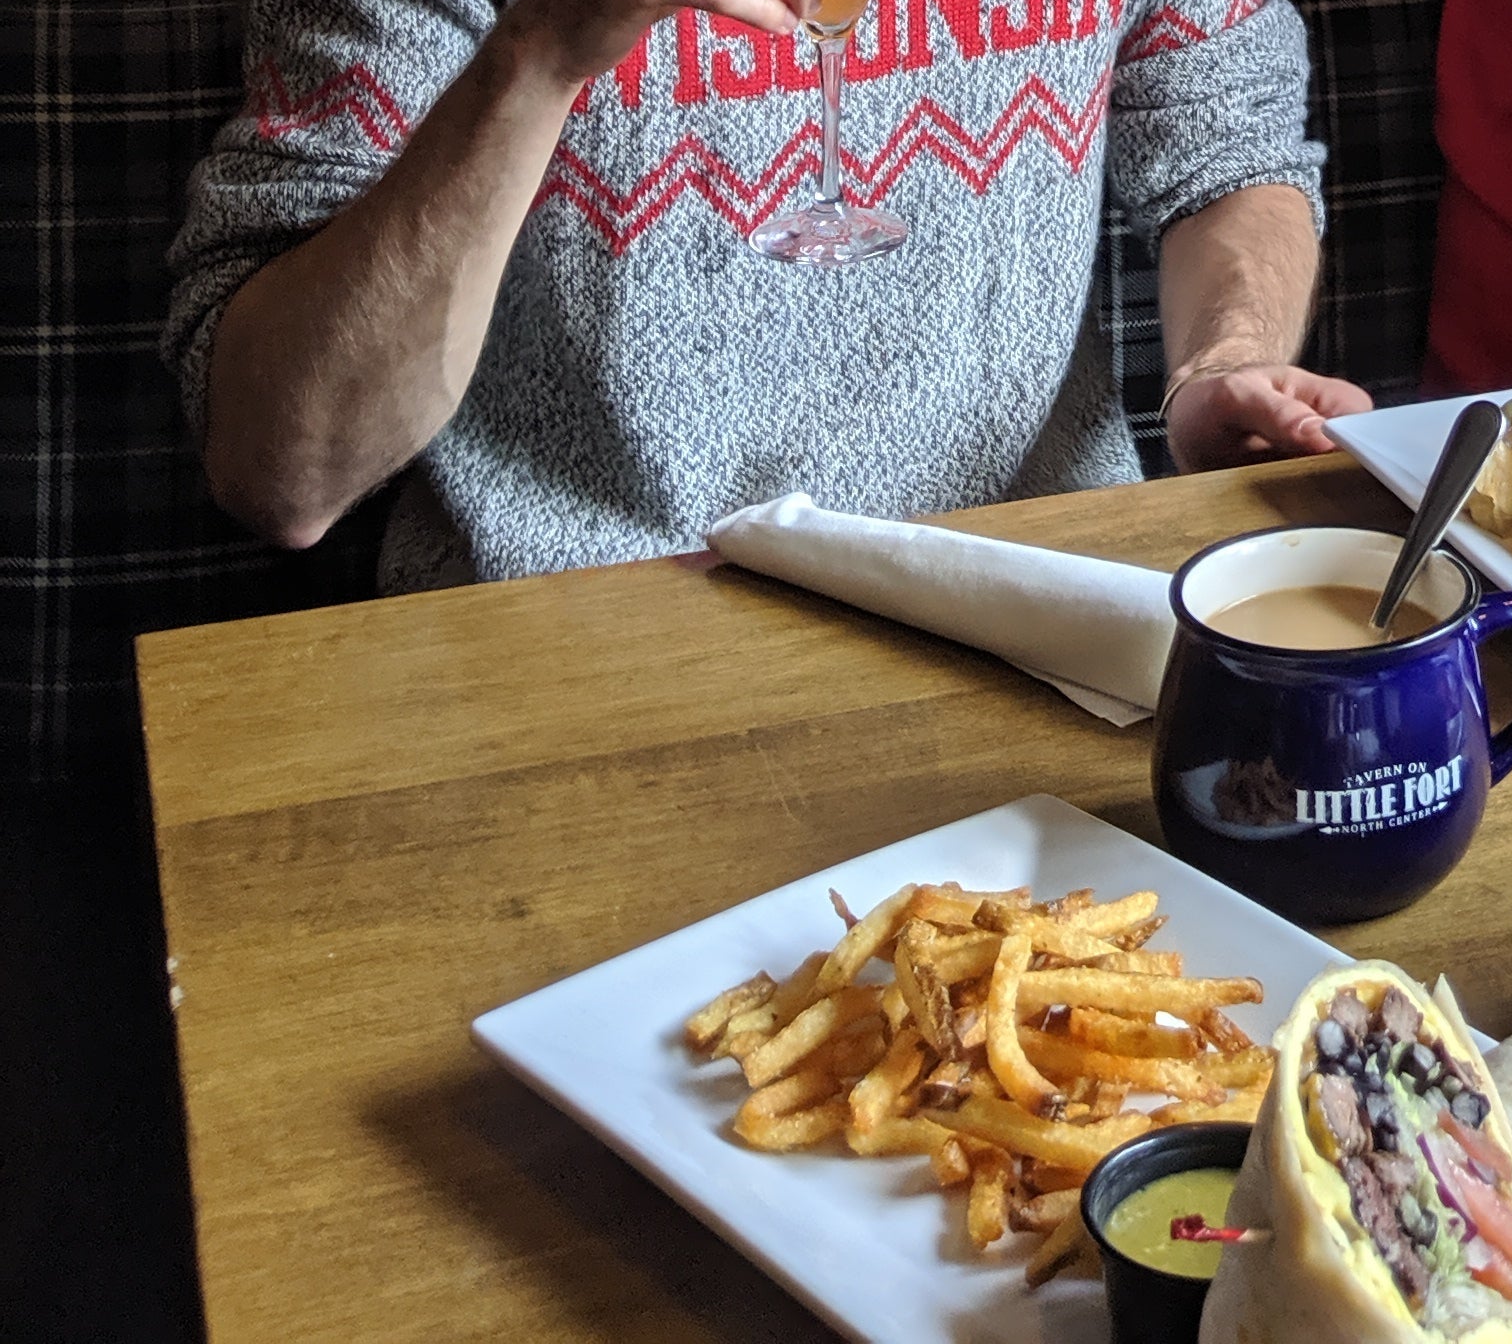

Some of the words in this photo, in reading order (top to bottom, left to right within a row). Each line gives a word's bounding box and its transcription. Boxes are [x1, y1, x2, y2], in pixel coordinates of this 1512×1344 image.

[1343, 763, 1403, 789] TAVERN
[1408, 761, 1428, 774] ON
[1295, 783, 1398, 824] LITTLE
[1403, 755, 1462, 812] FORT
[1342, 820, 1384, 834] NORTH
[1389, 808, 1432, 827] CENTER
